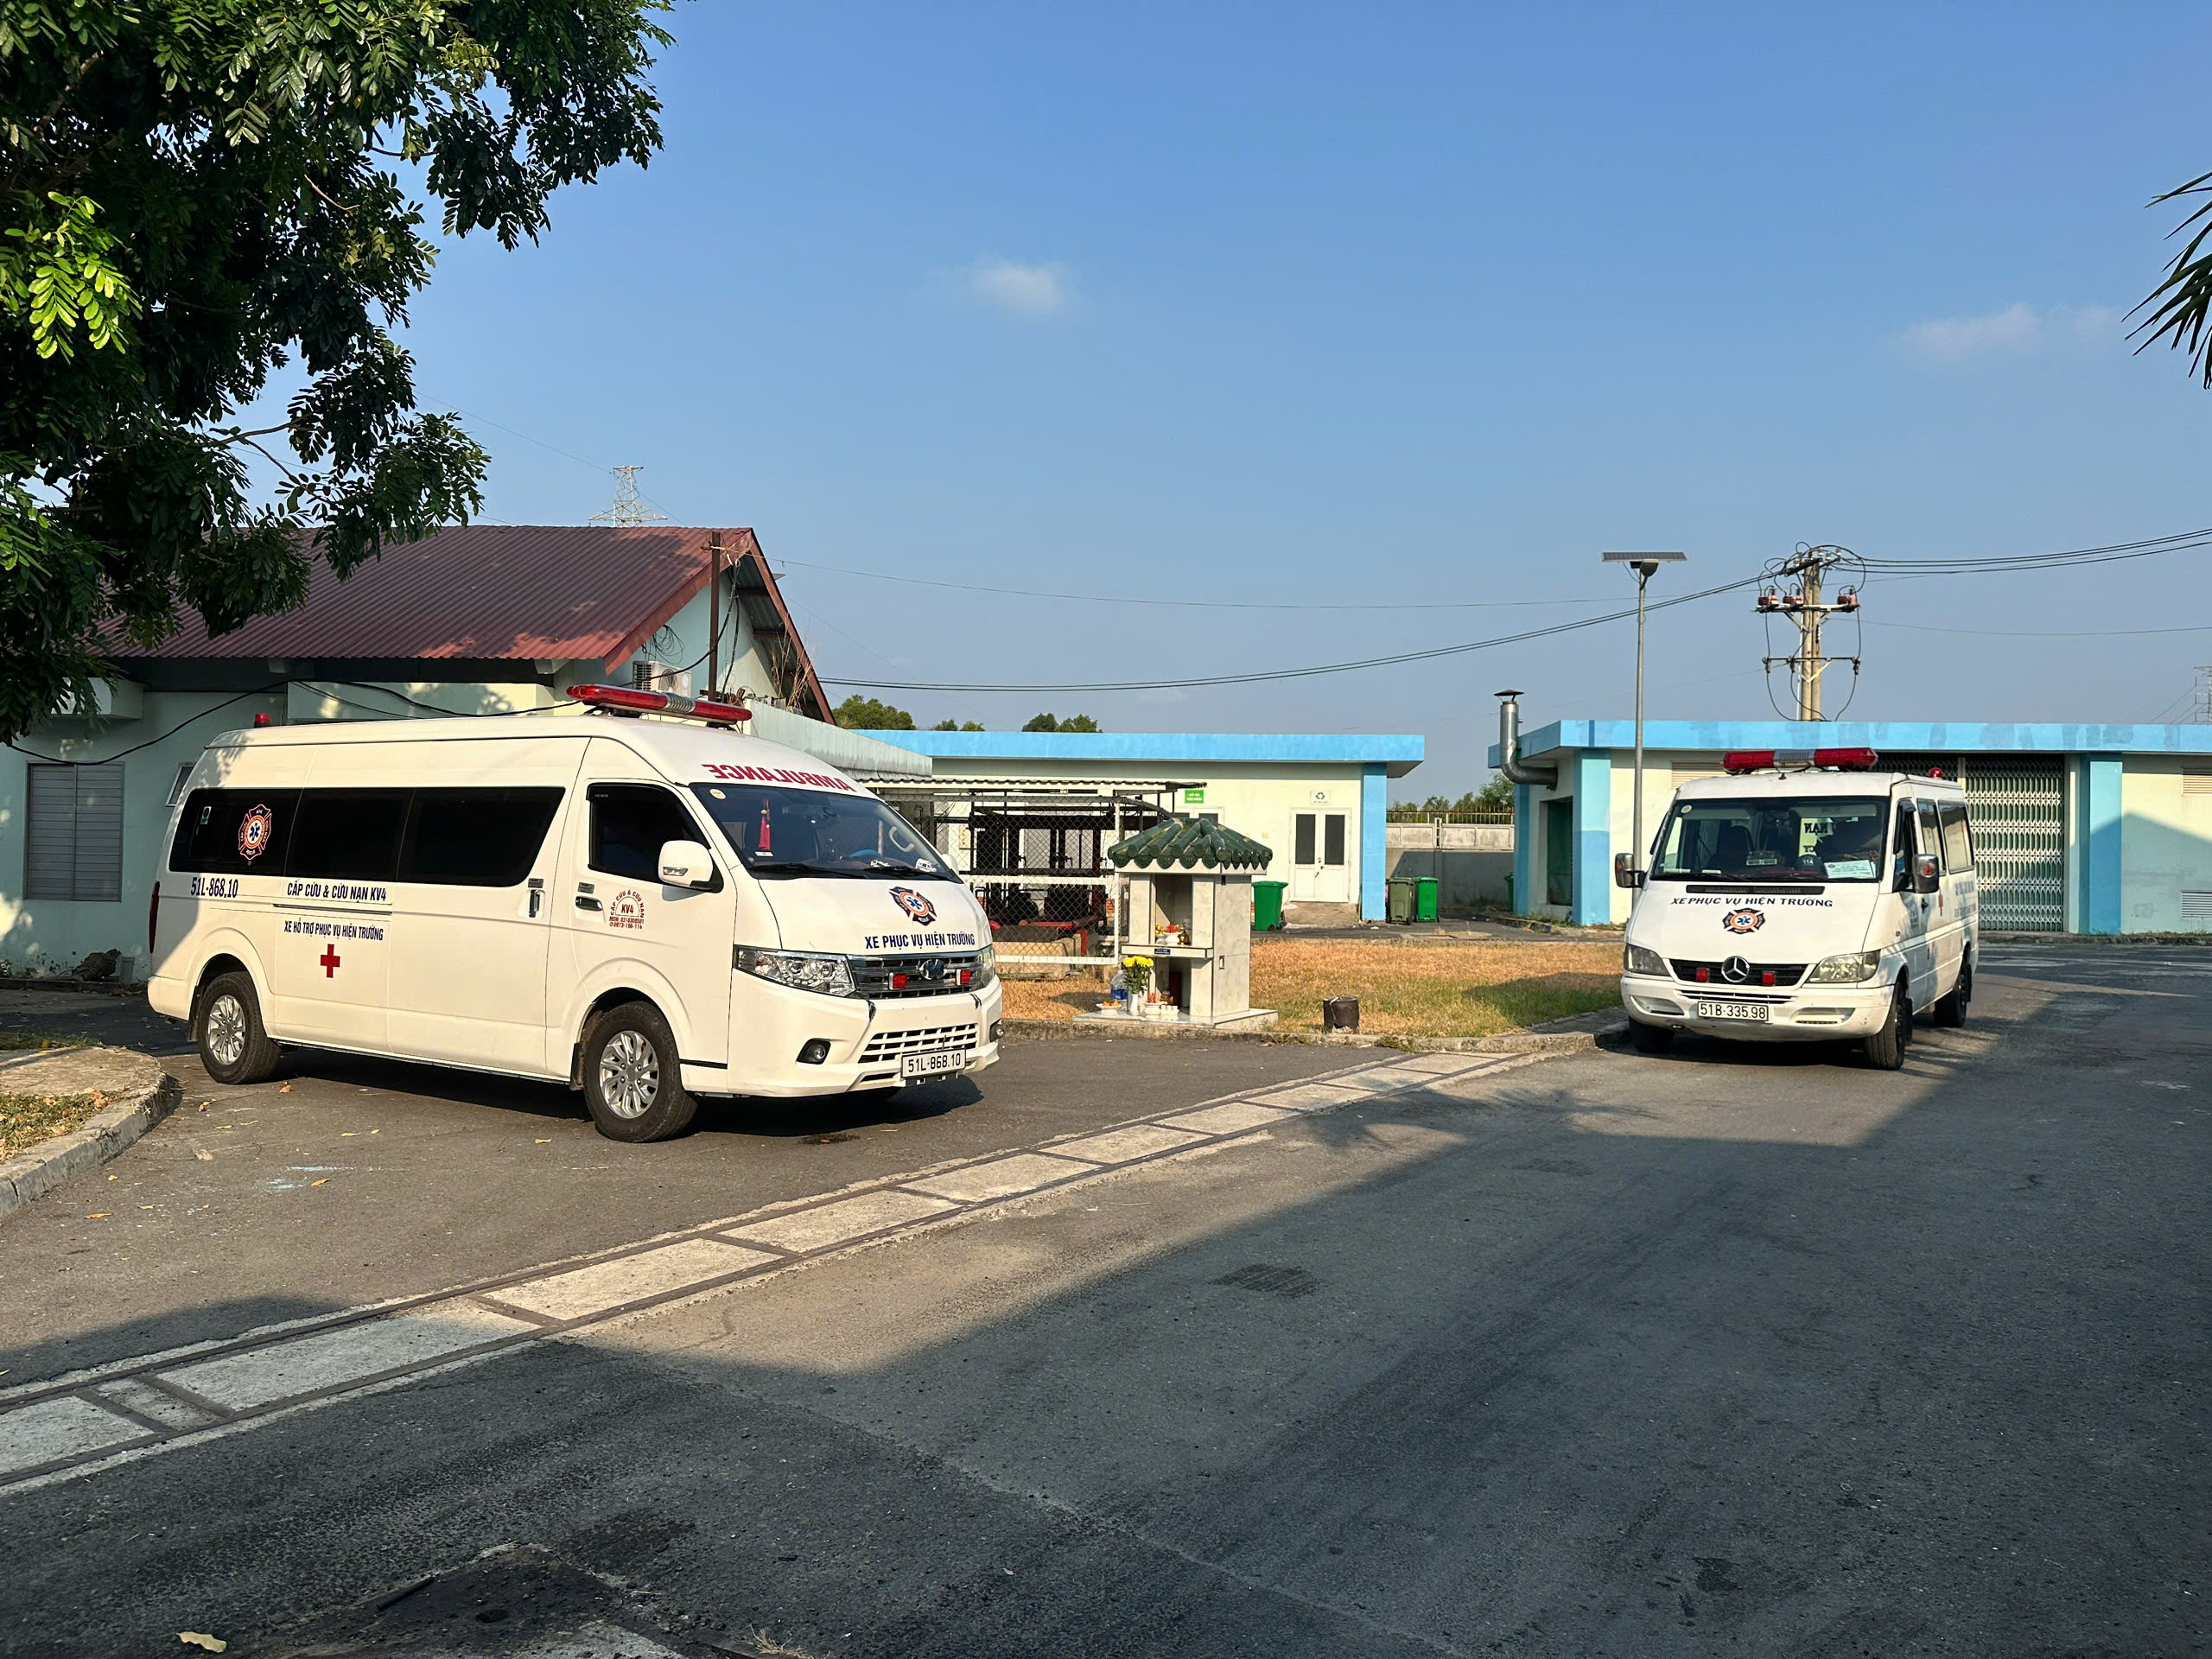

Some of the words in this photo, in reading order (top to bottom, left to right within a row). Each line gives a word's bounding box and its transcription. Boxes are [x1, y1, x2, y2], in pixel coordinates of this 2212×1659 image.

[287, 879, 303, 896] CẤP
[304, 881, 321, 897] CỨU
[323, 885, 329, 898] &
[332, 882, 348, 899] CỨU
[350, 887, 369, 903] NẠN
[370, 887, 386, 901] KV4
[621, 904, 634, 914] KV4
[1688, 898, 1721, 906] PHỤC
[1726, 898, 1742, 906] VỤ
[1745, 897, 1776, 906] HIỆN
[1780, 897, 1833, 907] TRƯỜNG
[284, 920, 292, 932] XE
[302, 921, 315, 938] TRỢ
[315, 923, 332, 938] PHỤC
[333, 925, 341, 939] VỤ
[342, 923, 357, 940] HIỆN
[359, 925, 384, 941] TRƯỜNG
[864, 936, 880, 949] XE
[882, 934, 909, 950] PHỤC
[911, 934, 923, 950] VỤ
[925, 931, 945, 949] HIỆN
[947, 931, 975, 945] TRƯỜNG
[1700, 1003, 1765, 1019] 51B-335.98
[908, 1053, 961, 1072] 51L-868.10
